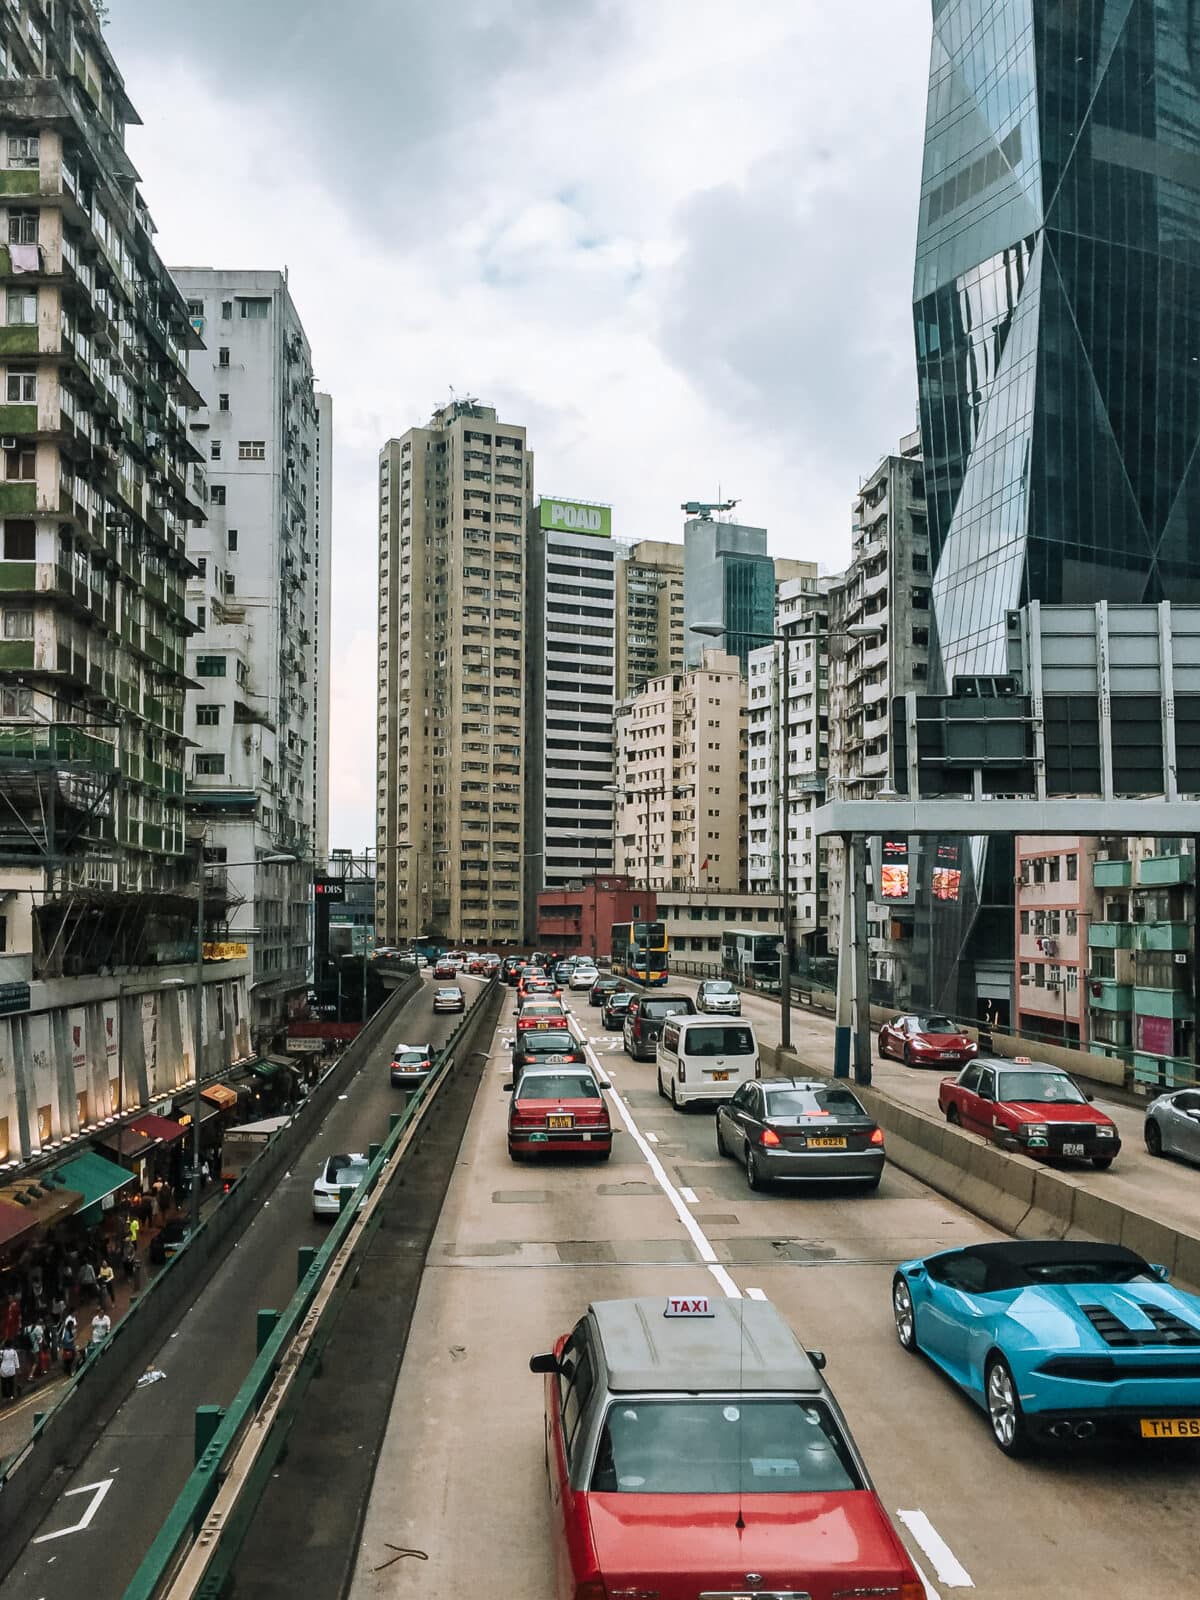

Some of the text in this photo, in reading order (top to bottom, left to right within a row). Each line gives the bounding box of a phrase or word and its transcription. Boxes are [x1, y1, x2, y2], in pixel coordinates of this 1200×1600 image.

[551, 504, 602, 530] POAD
[324, 884, 342, 894] DBS
[671, 1300, 708, 1313] TAXI
[1149, 1421, 1173, 1436] TH
